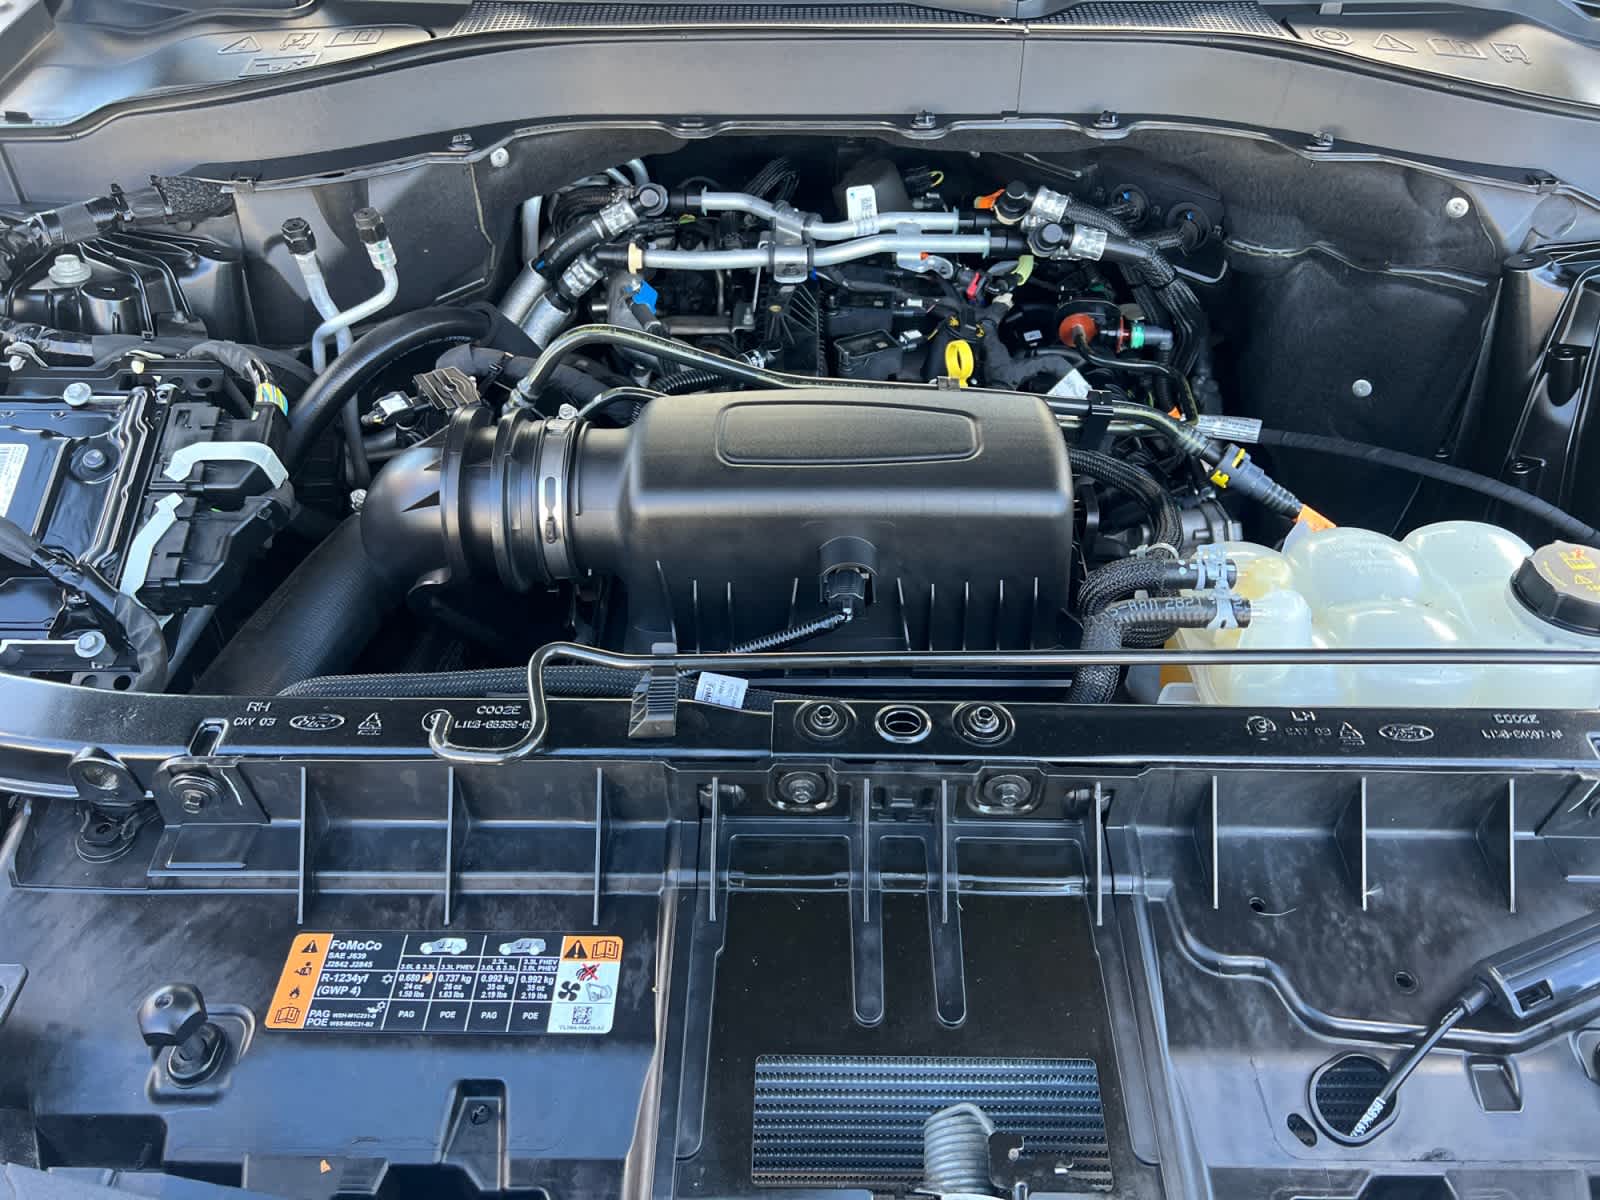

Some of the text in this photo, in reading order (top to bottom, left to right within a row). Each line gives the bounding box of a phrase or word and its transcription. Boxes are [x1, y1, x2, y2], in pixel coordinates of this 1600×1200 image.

[246, 701, 271, 712] RH
[1290, 711, 1316, 721] LH
[330, 940, 382, 950] FoMoCo
[321, 973, 370, 984] R-1234yf
[438, 974, 472, 984] 0.737 kg
[480, 974, 515, 984] 0.992 kg
[520, 975, 554, 985] 0.992 kg
[316, 985, 361, 997] (GWP 4)
[413, 990, 425, 998] lbs
[496, 991, 508, 999] lbs
[536, 992, 548, 1000] lbs
[308, 1009, 331, 1018] PAG
[398, 1010, 415, 1018] PAG
[480, 1011, 498, 1019] PAG
[522, 1012, 540, 1020] POE
[306, 1018, 329, 1026] POE
